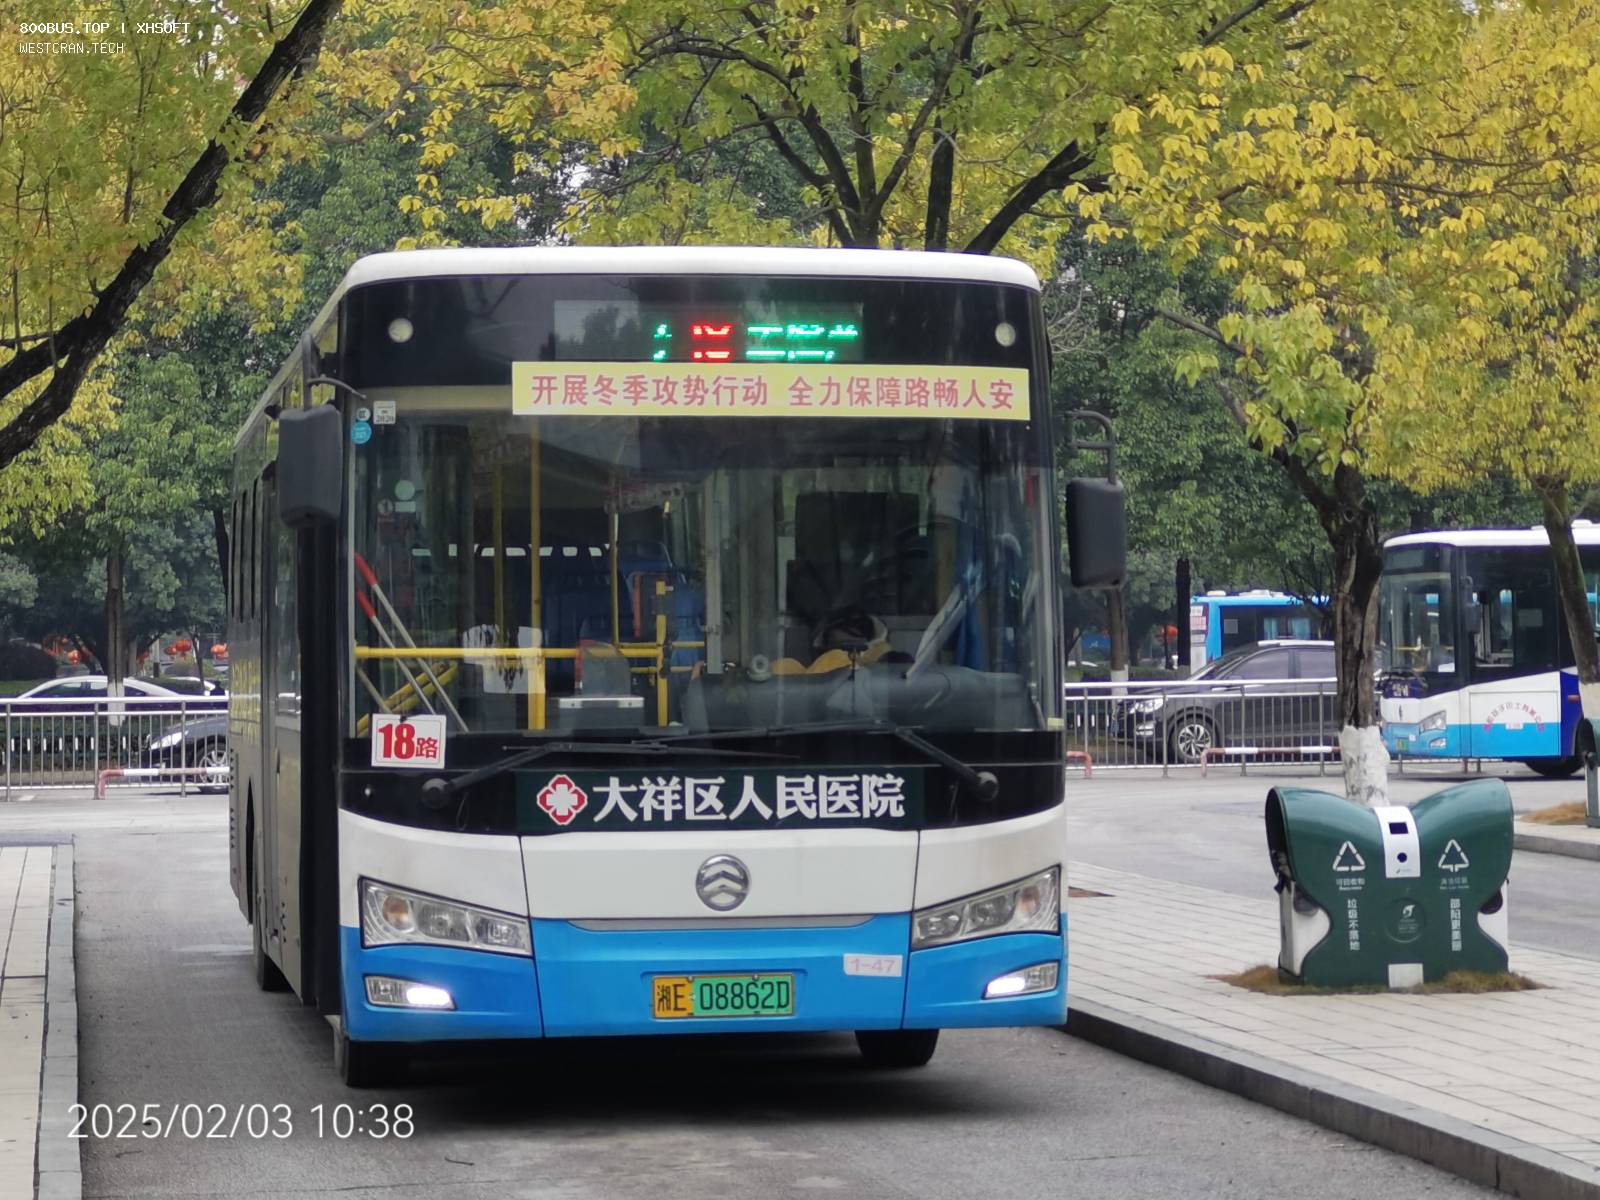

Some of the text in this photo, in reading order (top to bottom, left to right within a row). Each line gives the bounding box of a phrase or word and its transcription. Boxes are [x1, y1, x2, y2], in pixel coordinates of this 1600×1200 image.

[531, 373, 1015, 412] 开展冬季攻势行动 全力保障路畅人安
[378, 724, 440, 759] 18路
[592, 773, 906, 822] 大祥区人民医院
[1347, 897, 1361, 951] 垃圾不落地
[851, 957, 897, 973] 1-47
[656, 980, 791, 1012] 湘E 08862D
